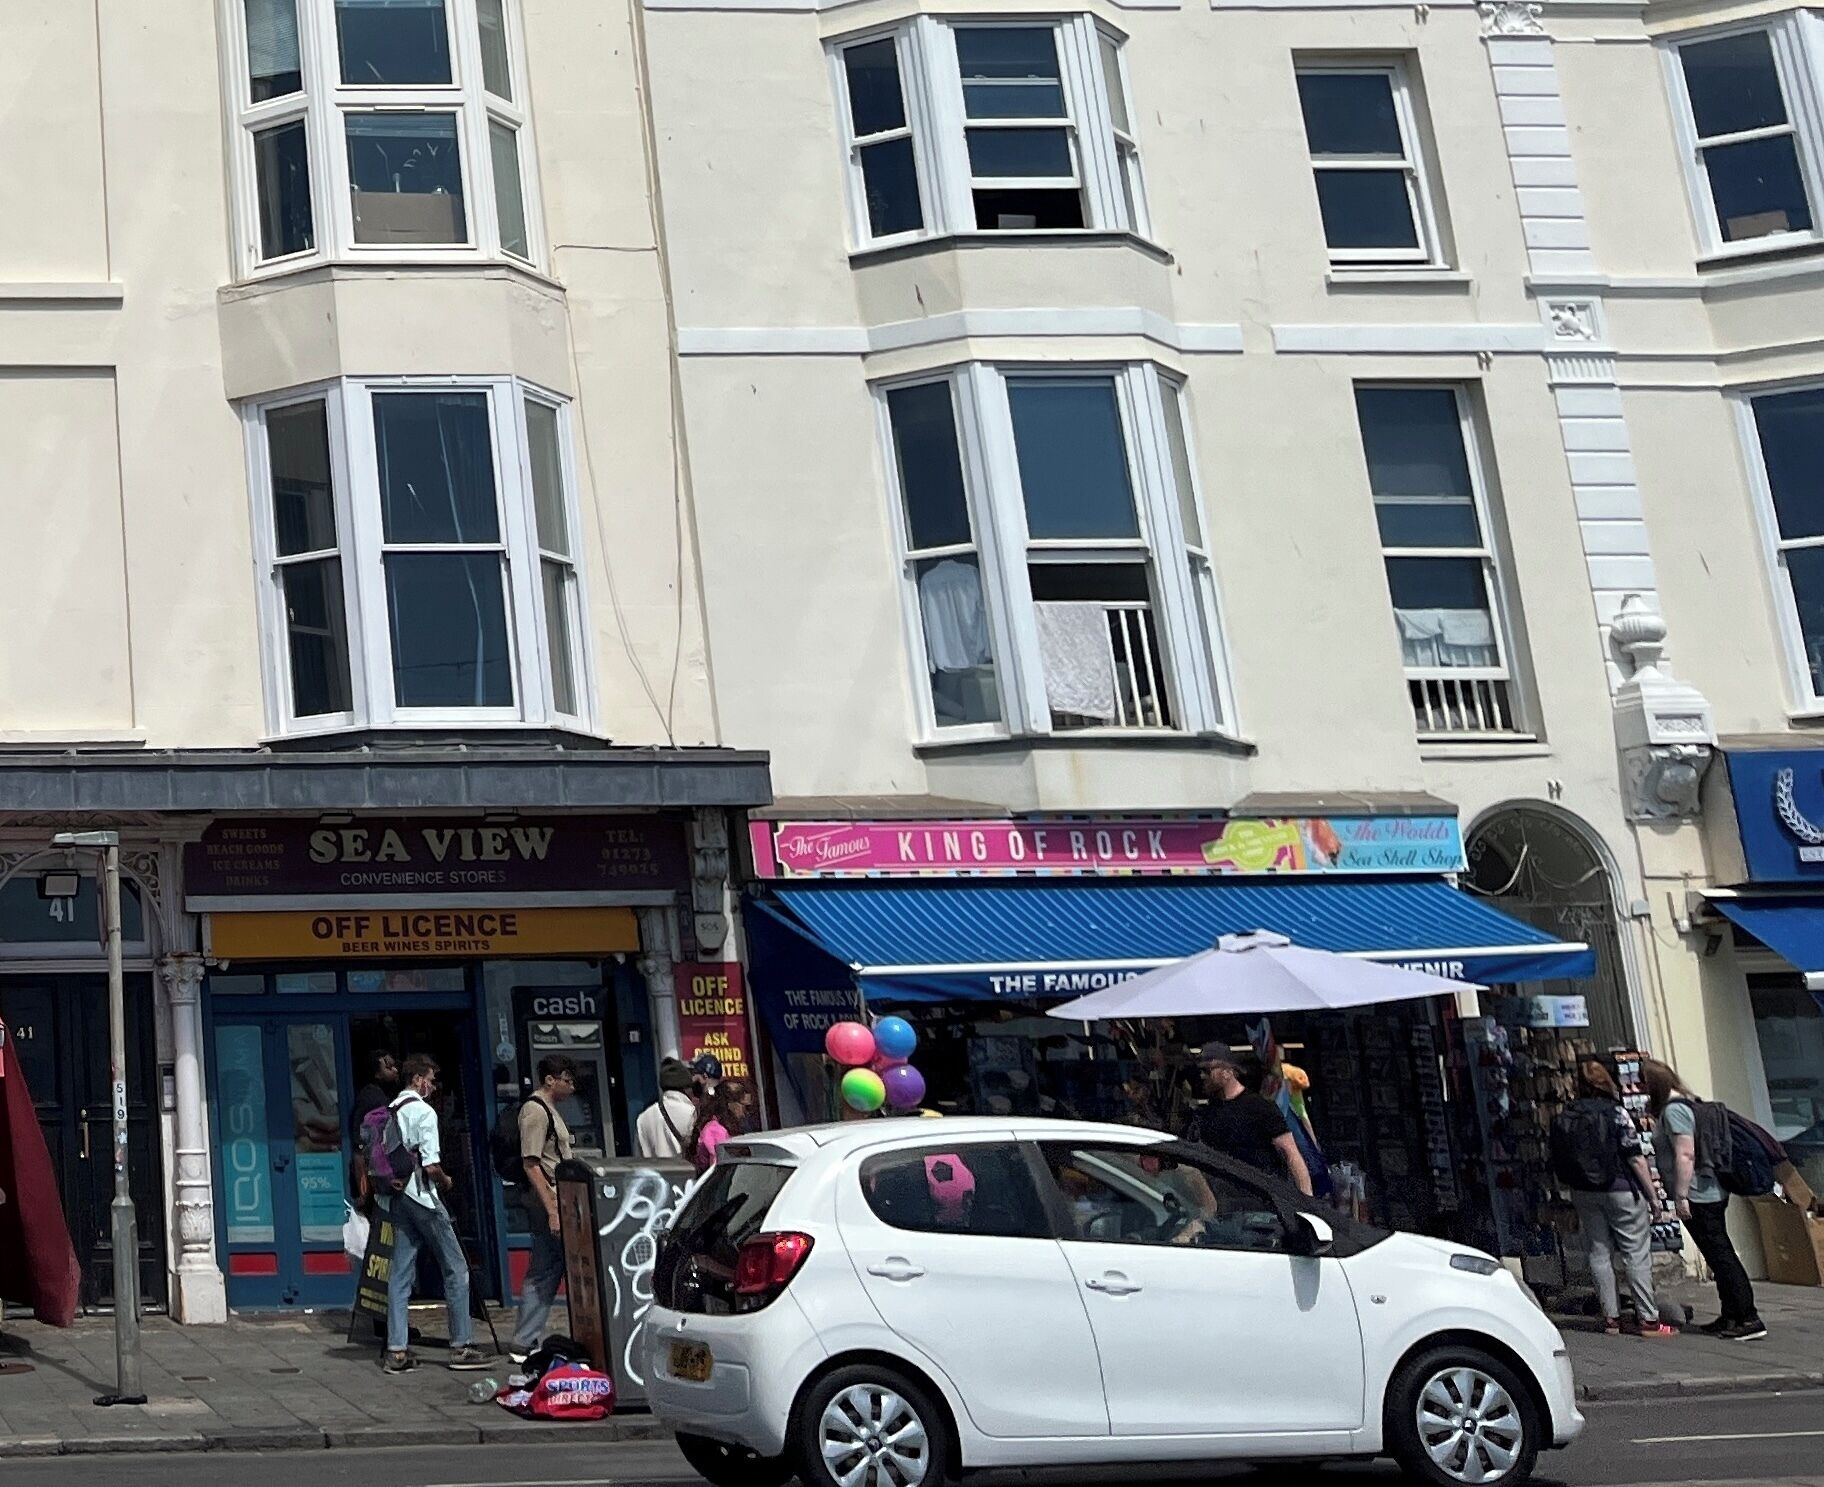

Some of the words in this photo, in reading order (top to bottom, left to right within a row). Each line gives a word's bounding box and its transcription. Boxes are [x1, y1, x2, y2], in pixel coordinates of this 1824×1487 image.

[222, 828, 267, 840] SWEETS
[206, 843, 243, 855] BEACH
[246, 843, 284, 855] GOODS
[309, 827, 412, 863] SEA
[421, 826, 555, 862] VIEW
[787, 835, 815, 858] The
[814, 834, 871, 861] Famous
[897, 830, 988, 862] KING
[1009, 830, 1048, 861] OF
[1071, 829, 1167, 861] ROCK
[212, 860, 232, 872] ICE
[233, 859, 280, 871] CREAMS
[1343, 849, 1374, 867] Sea
[1376, 847, 1418, 867] Shell
[1422, 846, 1464, 870] Shop
[225, 875, 270, 888] DRINKS
[340, 870, 445, 887] CONVENIENCE
[449, 869, 506, 885] STORES
[49, 896, 75, 923] 41
[311, 916, 371, 940] OFF
[382, 913, 518, 939] LICENCE
[342, 941, 380, 953] BEER
[383, 940, 430, 953] WINES
[435, 939, 491, 952] SPIRITS
[691, 975, 728, 998] OFF
[989, 975, 1037, 994] THE
[533, 991, 596, 1015] cash
[680, 998, 744, 1016] LICENCE
[784, 990, 810, 1007] THE
[783, 1013, 800, 1030] OF
[801, 1013, 831, 1030] ROCK
[16, 1026, 33, 1039] 41
[704, 1031, 729, 1047] ASK
[230, 1101, 261, 1222] IQOS
[301, 1176, 331, 1189] 95%
